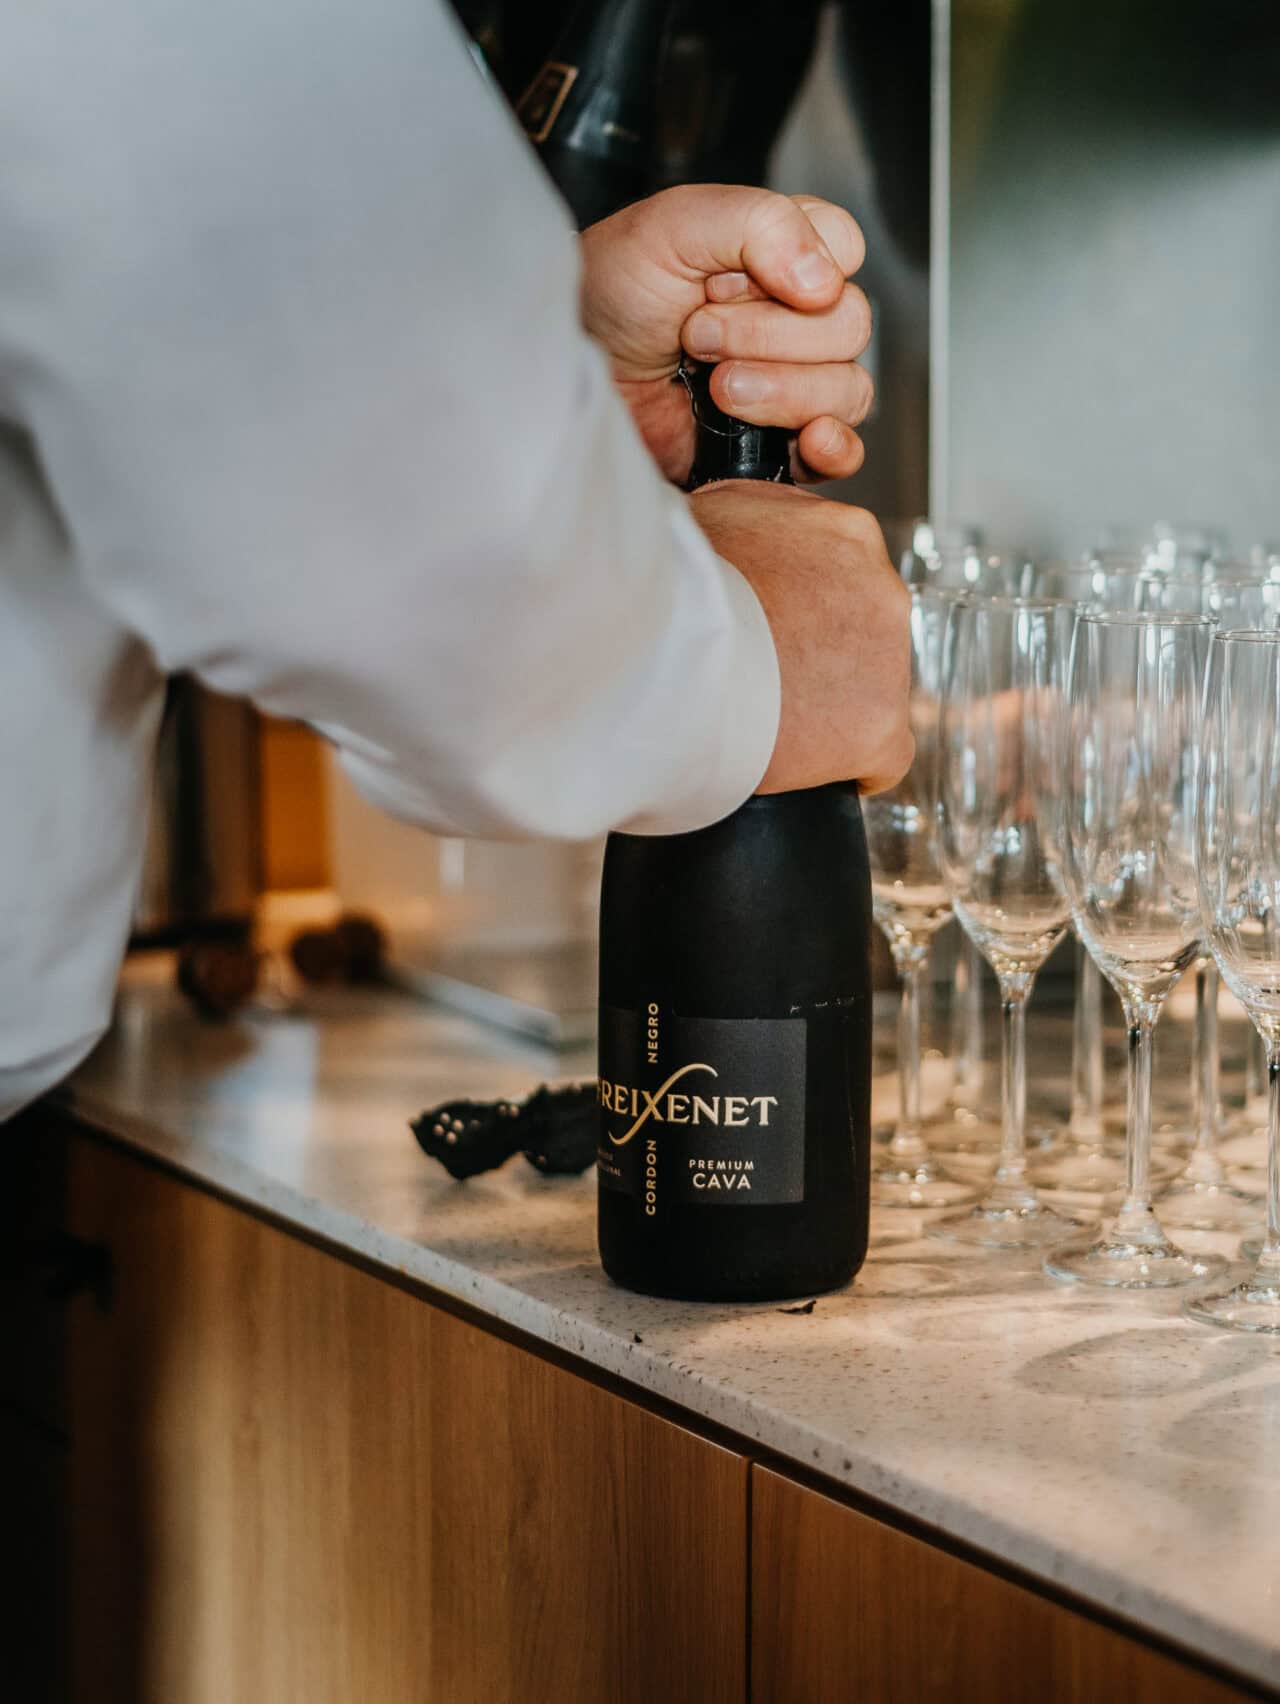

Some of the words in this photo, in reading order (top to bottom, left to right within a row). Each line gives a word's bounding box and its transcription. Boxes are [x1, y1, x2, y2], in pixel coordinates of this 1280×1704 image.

[648, 1002, 659, 1064] NEGRO
[645, 1139, 657, 1216] CORDON
[689, 1159, 755, 1171] PREMIUM
[692, 1173, 751, 1190] CAVA
